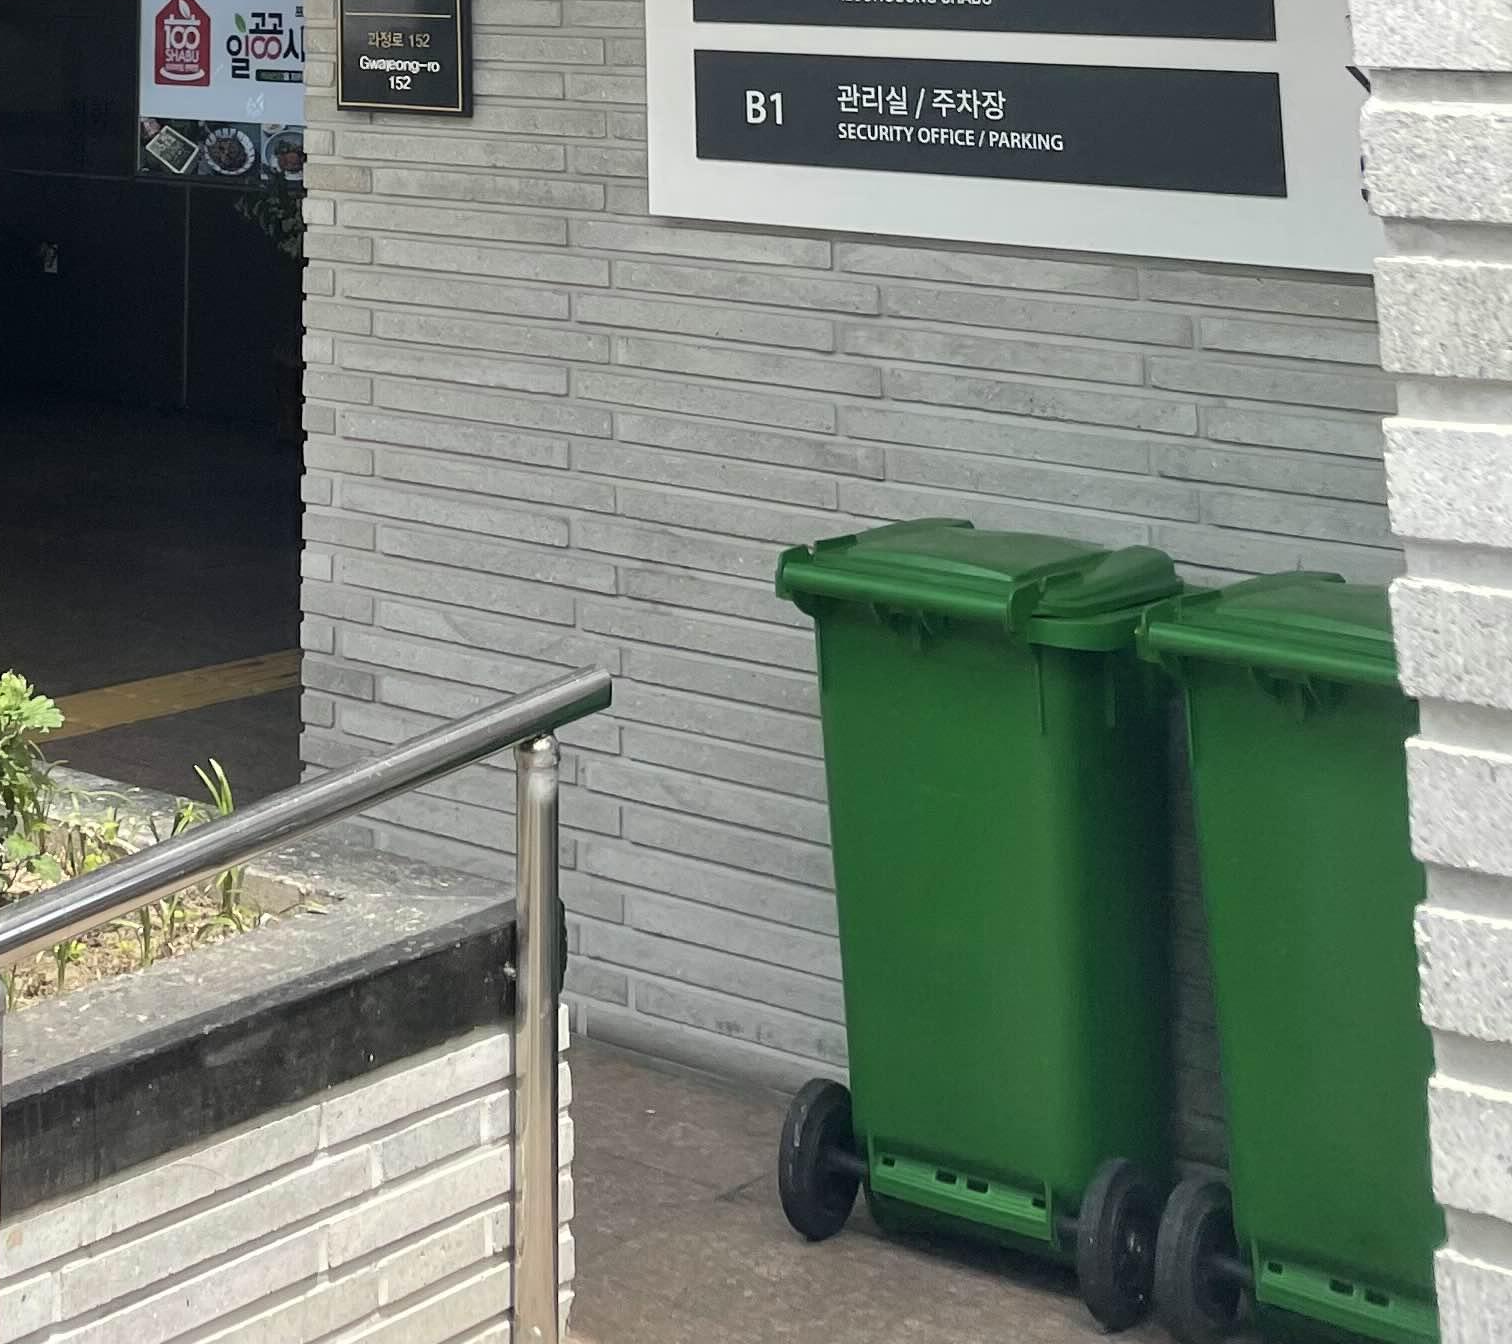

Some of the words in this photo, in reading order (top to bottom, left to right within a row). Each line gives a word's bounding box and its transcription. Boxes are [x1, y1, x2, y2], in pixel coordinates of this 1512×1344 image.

[367, 31, 404, 49] 과정로
[408, 31, 431, 48] 152
[165, 49, 200, 62] SHABU
[358, 54, 441, 75] Gwajeong-ro
[388, 75, 412, 90] 152
[746, 91, 782, 124] B1
[837, 84, 908, 115] 관리실
[915, 88, 925, 119] /
[932, 89, 1006, 120] 주차장
[839, 123, 914, 142] SECURITY
[918, 128, 975, 145] OFFICE
[989, 131, 1063, 150] PARKING
